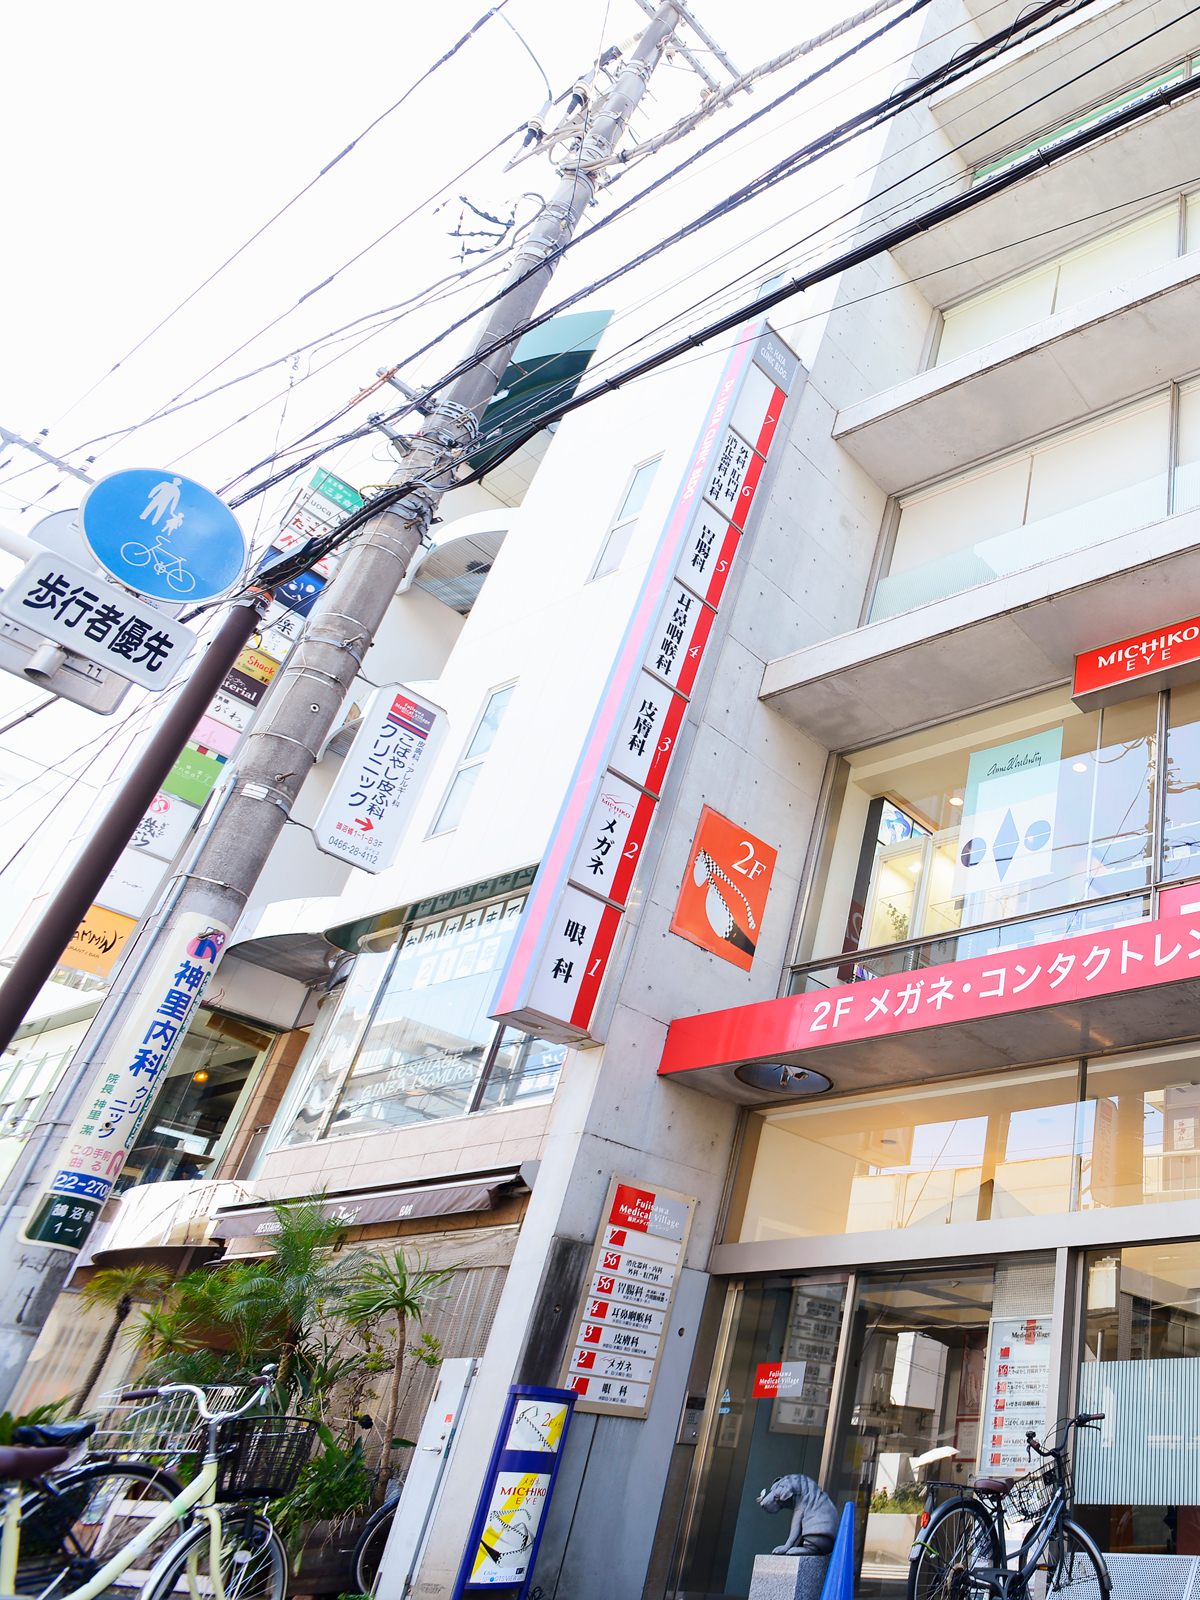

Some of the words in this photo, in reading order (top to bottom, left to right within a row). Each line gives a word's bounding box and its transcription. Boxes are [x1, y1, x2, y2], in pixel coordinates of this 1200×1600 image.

[760, 348, 777, 368] CLINIC
[774, 348, 787, 367] HATA
[709, 394, 730, 427] HATA
[764, 415, 776, 425] 7
[693, 427, 718, 467] CLINIC
[680, 465, 704, 504] BLDG.
[741, 485, 754, 497] 6
[691, 524, 716, 573] 胃腸科
[715, 559, 728, 573] 5
[23, 572, 174, 673] 歩行者優先
[655, 591, 694, 676] 耳鼻咽喉科
[688, 645, 701, 659] 4
[1097, 626, 1200, 669] MICHIKO
[247, 655, 275, 676] Shack
[1126, 648, 1171, 671] EYE
[628, 699, 658, 756] 皮膚科
[657, 737, 672, 752] 3
[349, 724, 398, 807] クリニック
[366, 733, 415, 821] こばやし皮ふ科
[328, 835, 378, 865] 0466-28-4112
[586, 818, 618, 876] メガネ
[623, 841, 639, 859] 2
[731, 840, 767, 881] 2F
[551, 918, 587, 984] 眼科
[587, 958, 602, 977] 1
[129, 961, 206, 1082] 神里内科
[809, 996, 852, 1033] 2F
[388, 1053, 462, 1081] KUSHIAGE
[101, 1073, 121, 1095] 院長
[86, 1099, 107, 1120] 神里
[70, 1144, 111, 1163] この手前
[398, 1204, 414, 1218] BAR
[619, 1204, 652, 1220] Medical
[654, 1214, 680, 1228] Village
[636, 1199, 669, 1215] Fujisawa
[53, 1222, 82, 1239] 1-1
[604, 1252, 617, 1266] 56
[597, 1275, 611, 1290] 56
[592, 1300, 601, 1314] 4
[611, 1307, 653, 1325] 耳鼻咽喉科
[584, 1325, 594, 1338] 3
[613, 1333, 640, 1347] 皮膚科
[578, 1350, 588, 1364] 2
[607, 1359, 632, 1372] メガネ
[571, 1376, 580, 1390] 1
[759, 1377, 780, 1385] Medical
[781, 1376, 800, 1385] Village
[769, 1370, 792, 1379] Fujisawa
[500, 1486, 547, 1498] MICHIKO
[516, 1497, 537, 1506] EYE
